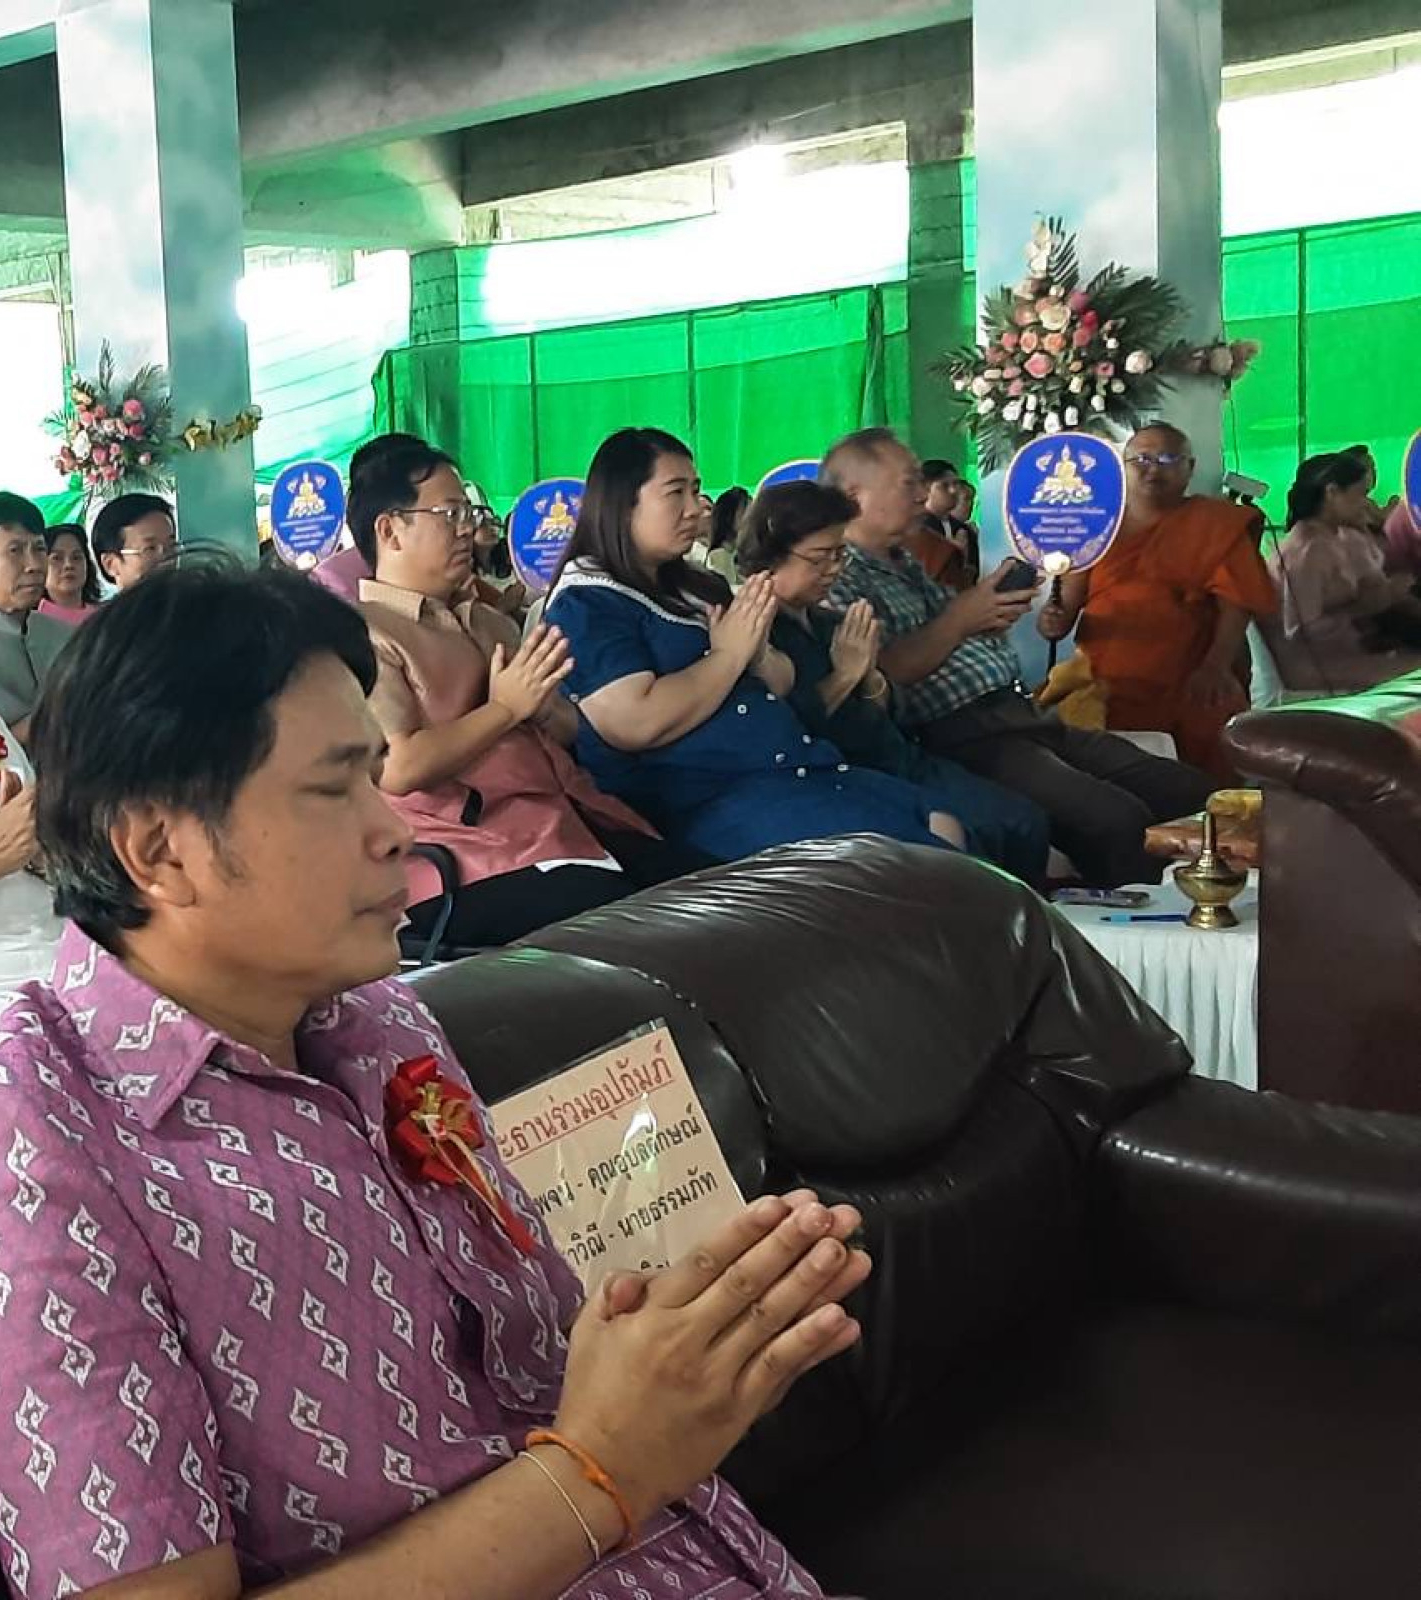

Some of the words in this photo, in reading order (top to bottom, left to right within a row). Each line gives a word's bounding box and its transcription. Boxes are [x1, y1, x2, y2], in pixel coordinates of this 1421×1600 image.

[497, 1039, 672, 1158] ะธานร่วมอุปถัมภ์
[562, 1221, 607, 1266] าวิณี
